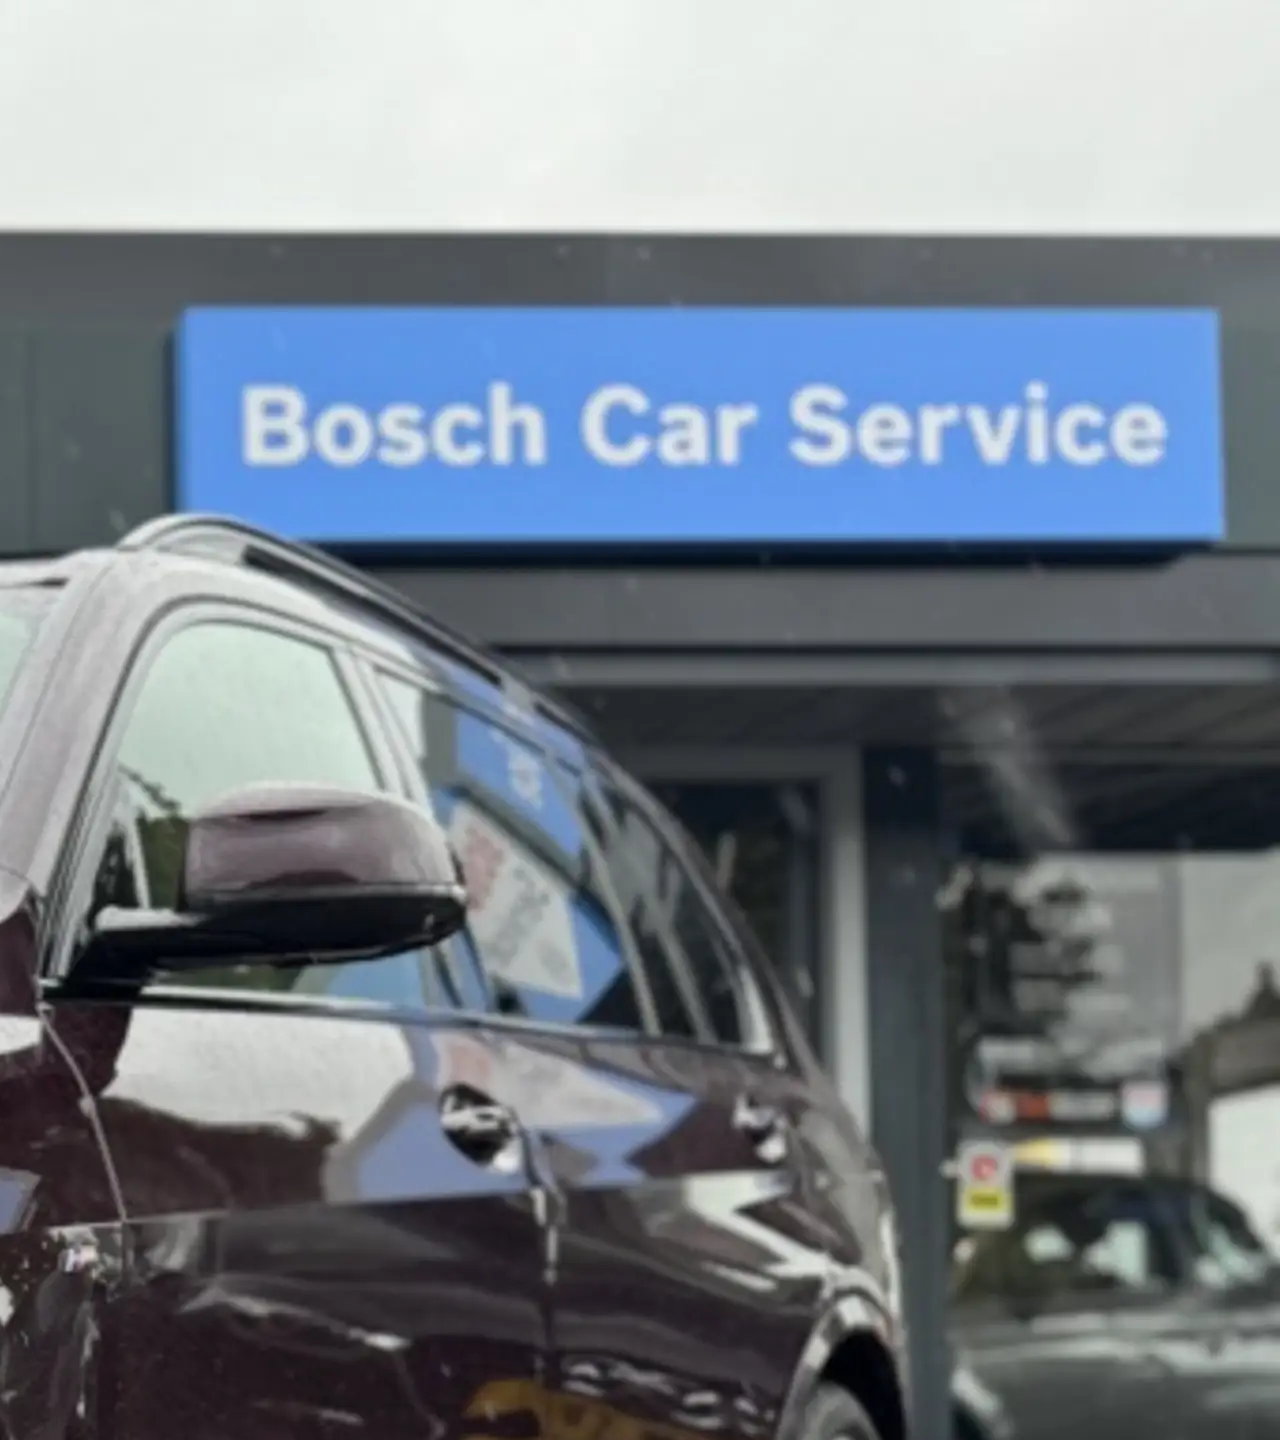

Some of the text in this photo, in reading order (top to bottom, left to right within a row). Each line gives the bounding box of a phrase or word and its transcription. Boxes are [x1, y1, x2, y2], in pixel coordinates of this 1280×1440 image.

[242, 383, 1166, 466] Bosch Car Service
